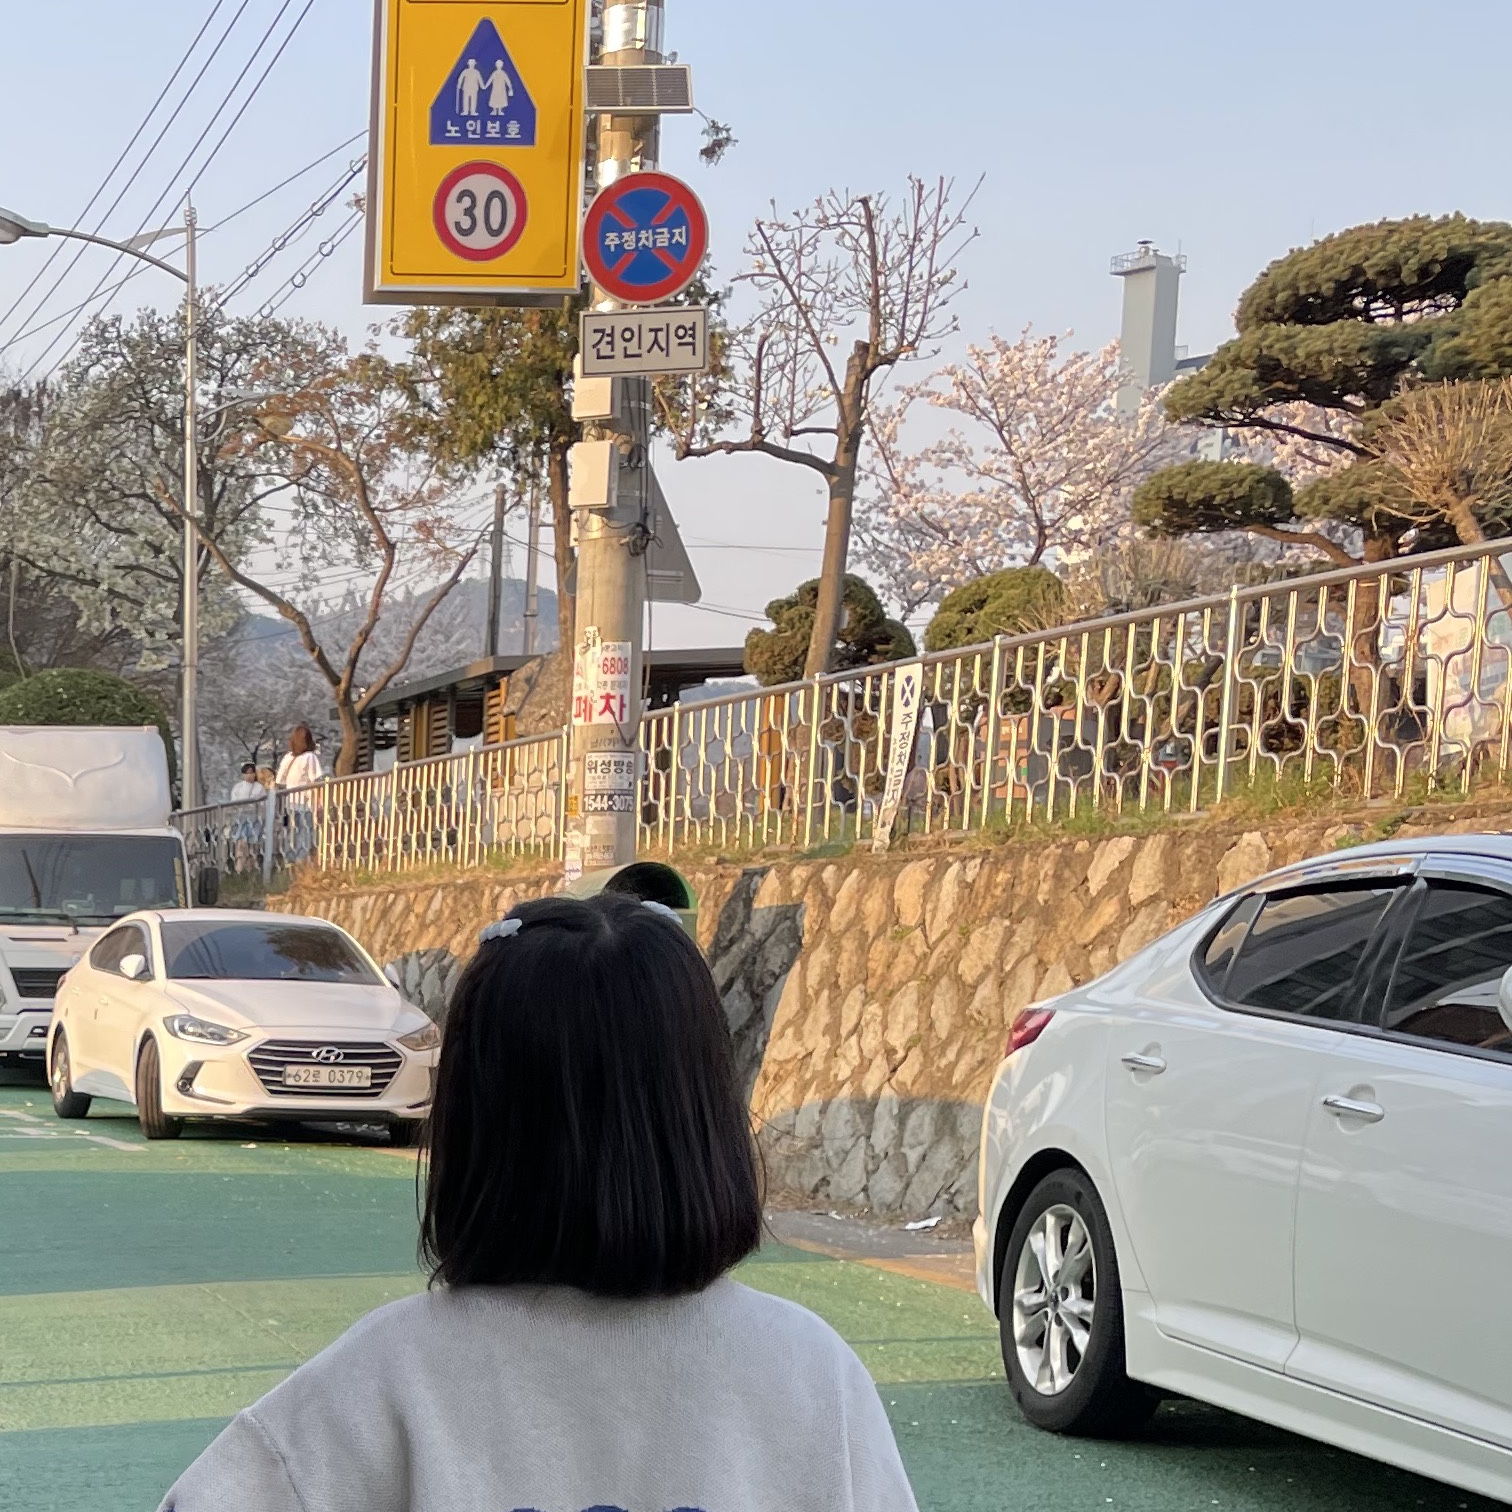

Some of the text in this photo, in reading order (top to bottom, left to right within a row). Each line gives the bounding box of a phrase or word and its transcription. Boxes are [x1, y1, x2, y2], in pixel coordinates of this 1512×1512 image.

[444, 119, 522, 140] 노인보호
[454, 188, 508, 238] 30
[603, 224, 687, 252] 주정차금지
[591, 321, 697, 361] 견인지역
[328, 1069, 364, 1084] 0379
